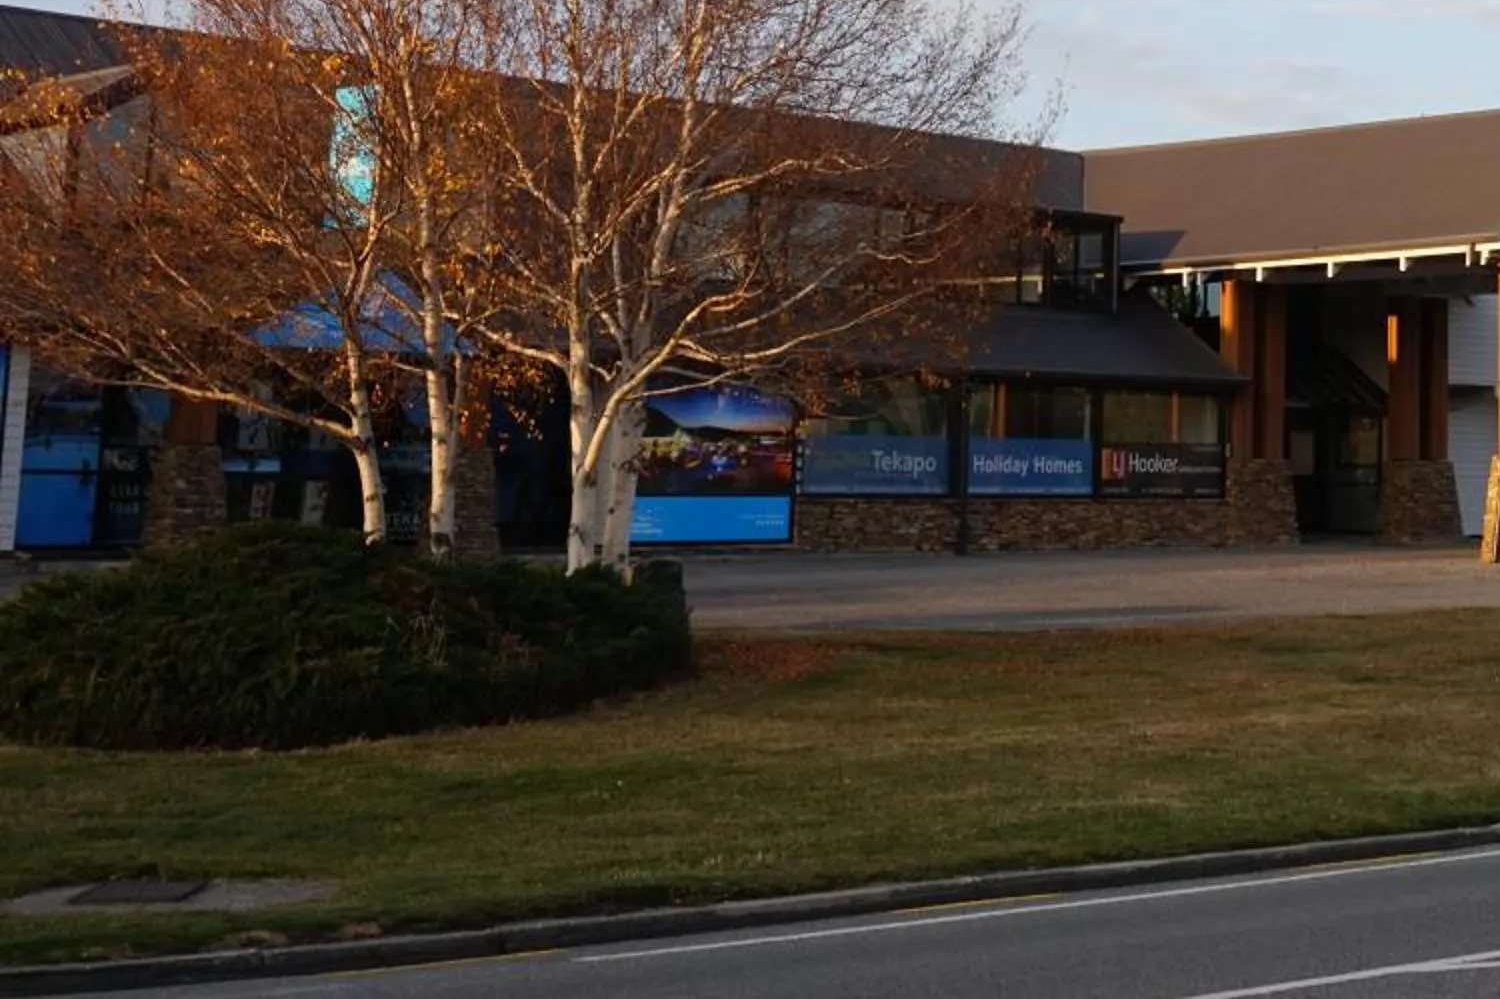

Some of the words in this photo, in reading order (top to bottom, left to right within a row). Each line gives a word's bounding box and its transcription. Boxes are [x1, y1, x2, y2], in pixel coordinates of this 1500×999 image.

[872, 450, 937, 478] Tekapo
[973, 454, 1029, 477] Holiday
[1034, 456, 1083, 475] Homes
[1128, 451, 1179, 473] Hooker
